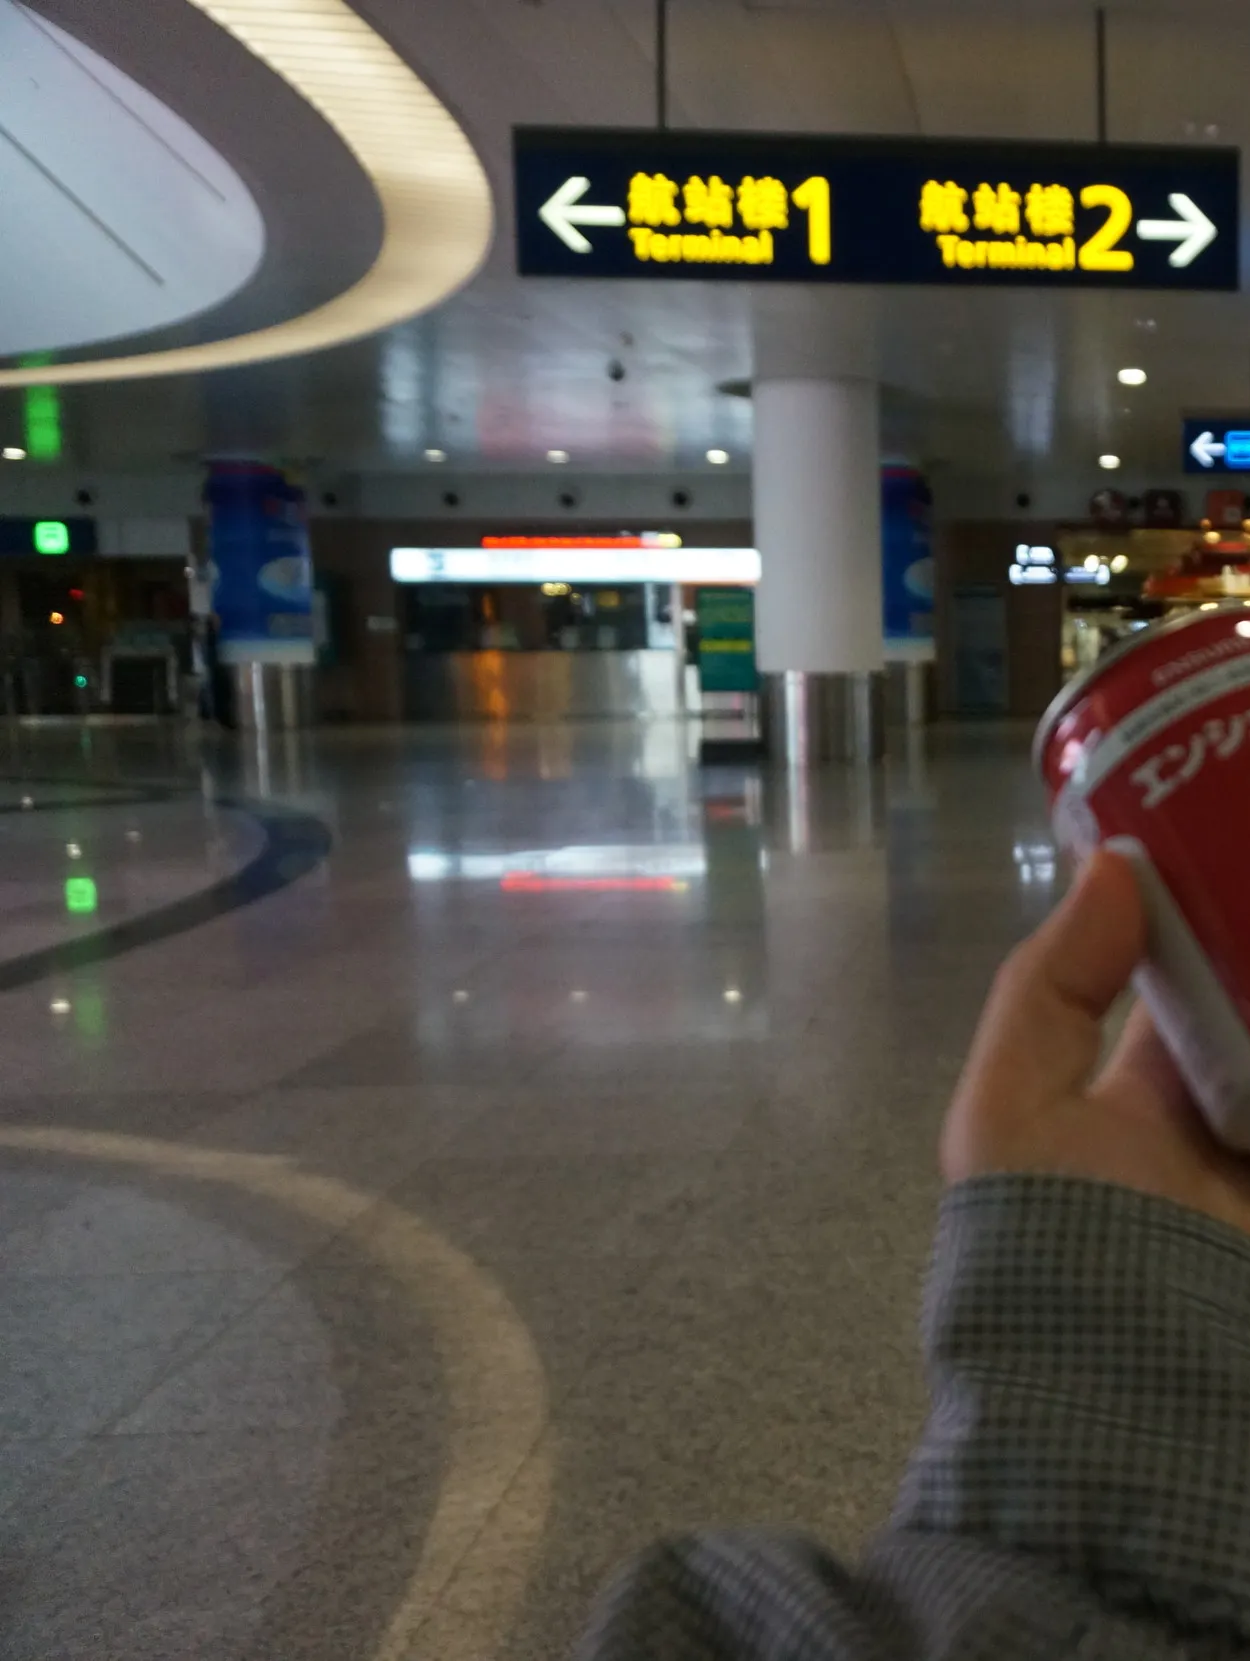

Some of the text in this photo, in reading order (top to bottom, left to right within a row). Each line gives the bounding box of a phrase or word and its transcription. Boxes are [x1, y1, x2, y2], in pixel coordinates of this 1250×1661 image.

[628, 227, 774, 265] Terminal
[792, 176, 831, 265] 1
[1078, 184, 1134, 271] 2
[936, 234, 1076, 271] Terminal
